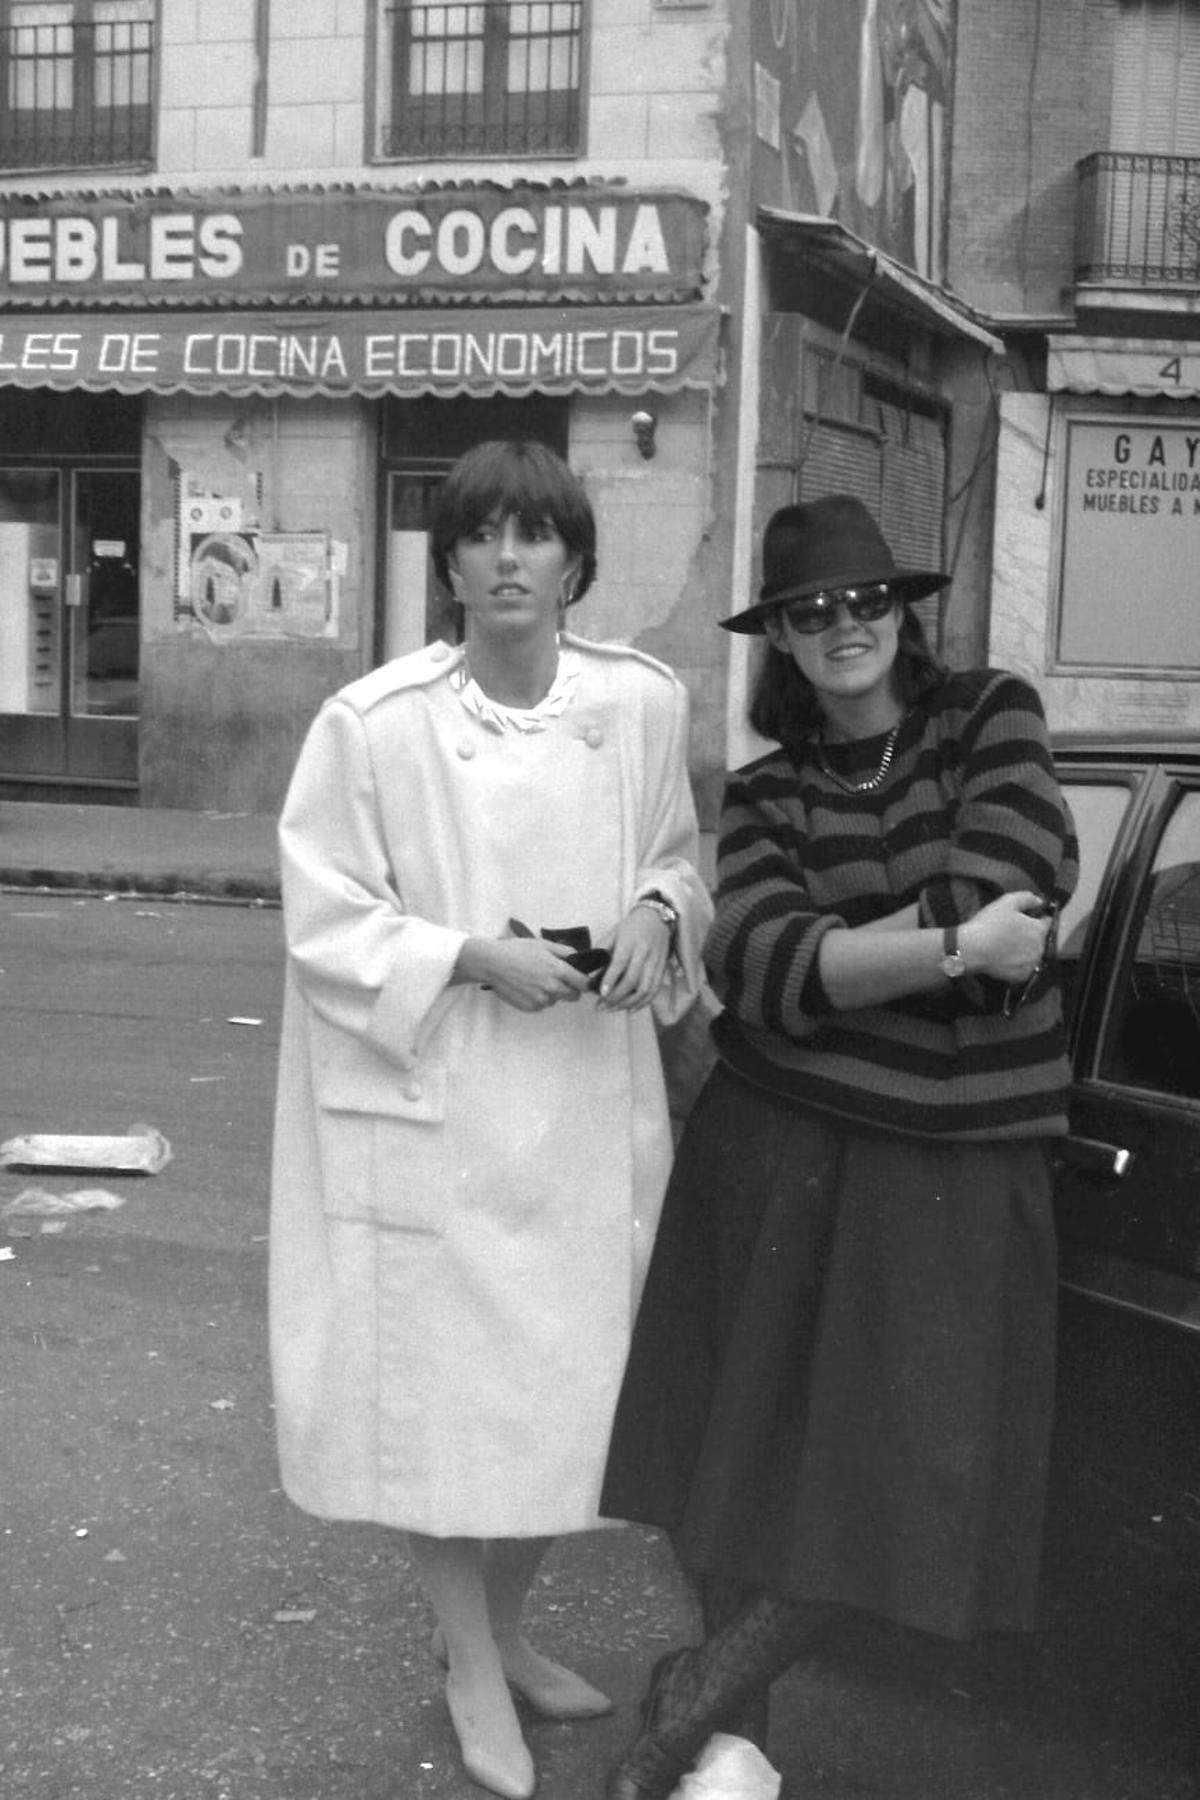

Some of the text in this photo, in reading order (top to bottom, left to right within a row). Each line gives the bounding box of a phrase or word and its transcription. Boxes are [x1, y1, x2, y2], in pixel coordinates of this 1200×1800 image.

[0, 204, 671, 282] EBLES DE COCINA
[98, 334, 161, 373] DE
[183, 333, 348, 378] COCINA
[365, 330, 679, 377] ECONOMICOS
[1083, 493, 1160, 515] MUEBLES
[1171, 497, 1183, 516] A
